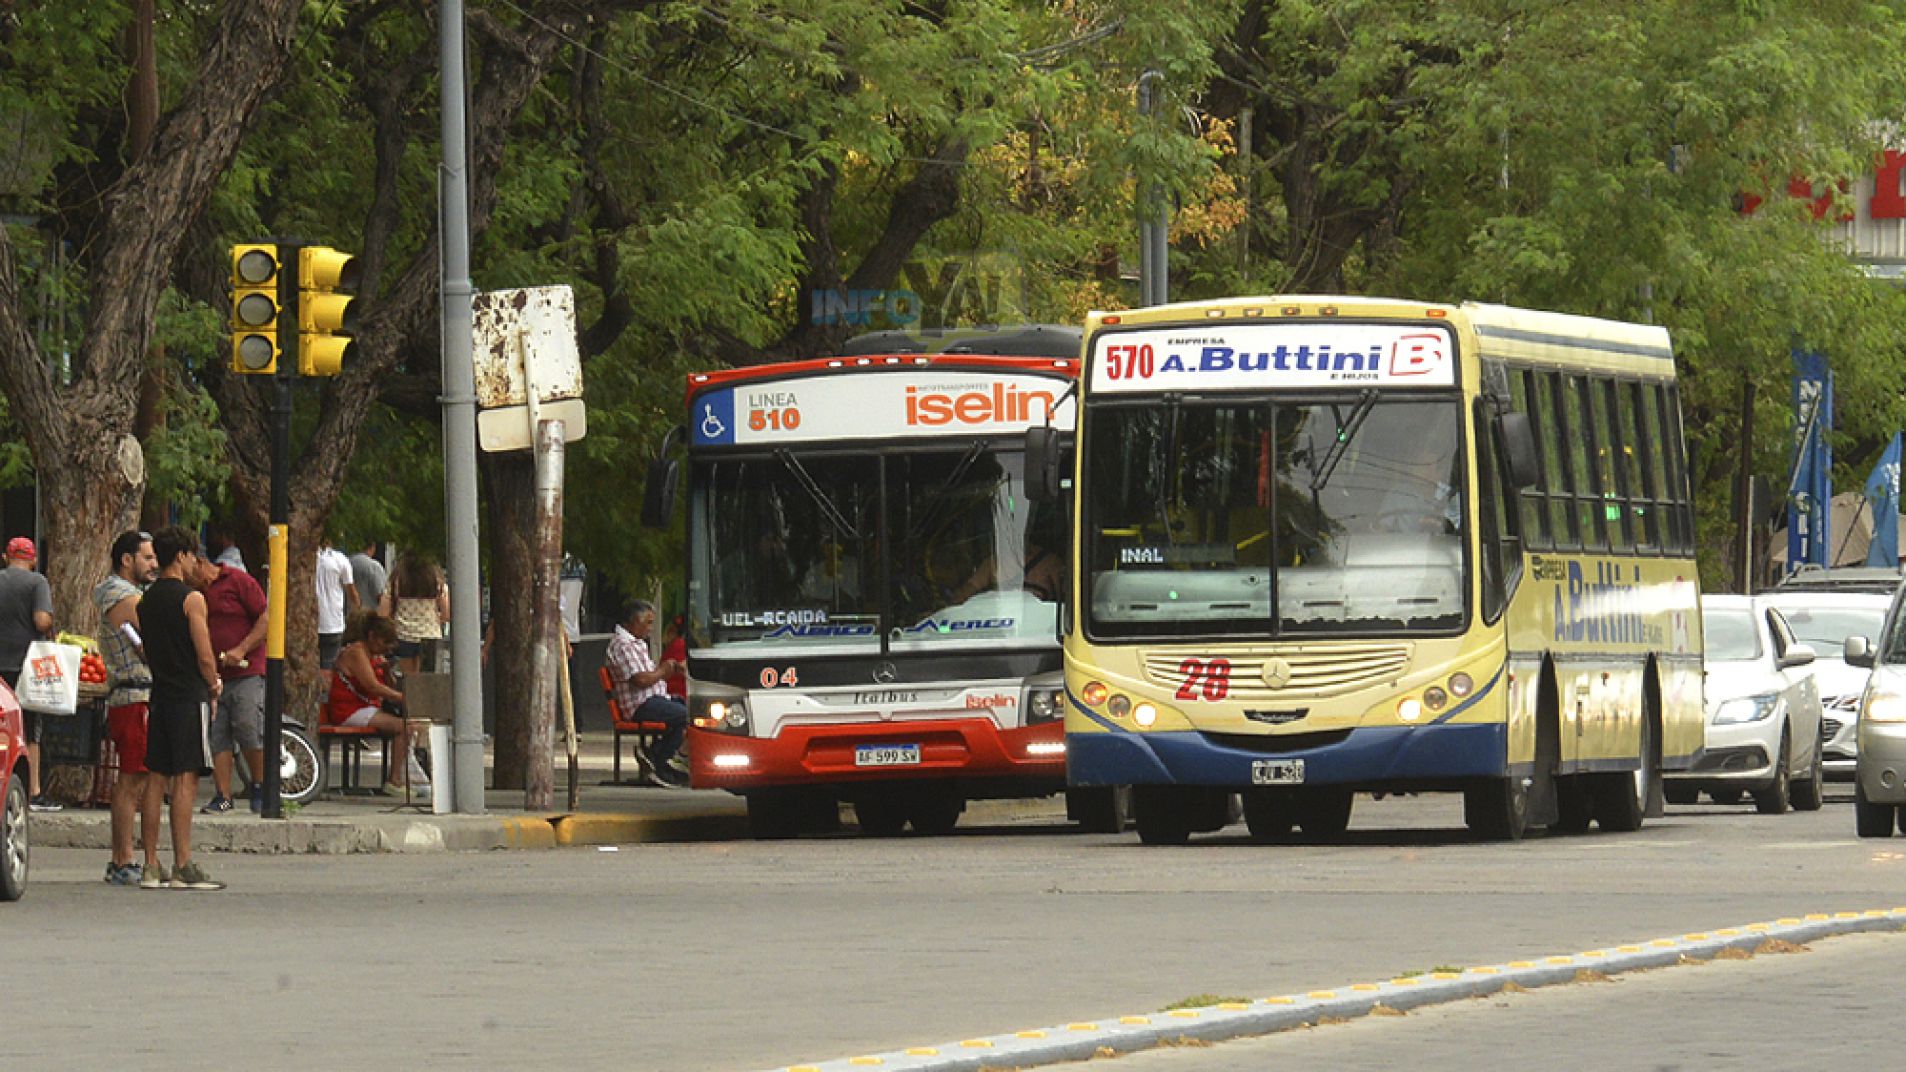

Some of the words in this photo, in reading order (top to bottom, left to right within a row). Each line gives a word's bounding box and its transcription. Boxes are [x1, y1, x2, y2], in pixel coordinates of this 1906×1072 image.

[1167, 337, 1226, 346] EMPRESA
[1106, 343, 1154, 380] 570
[748, 393, 798, 408] LINEA
[906, 382, 1055, 426] iselín
[749, 408, 800, 431] 510
[1121, 547, 1164, 563] INAL
[760, 666, 798, 689] 04
[1174, 656, 1231, 702] 28
[876, 750, 898, 762] 599
